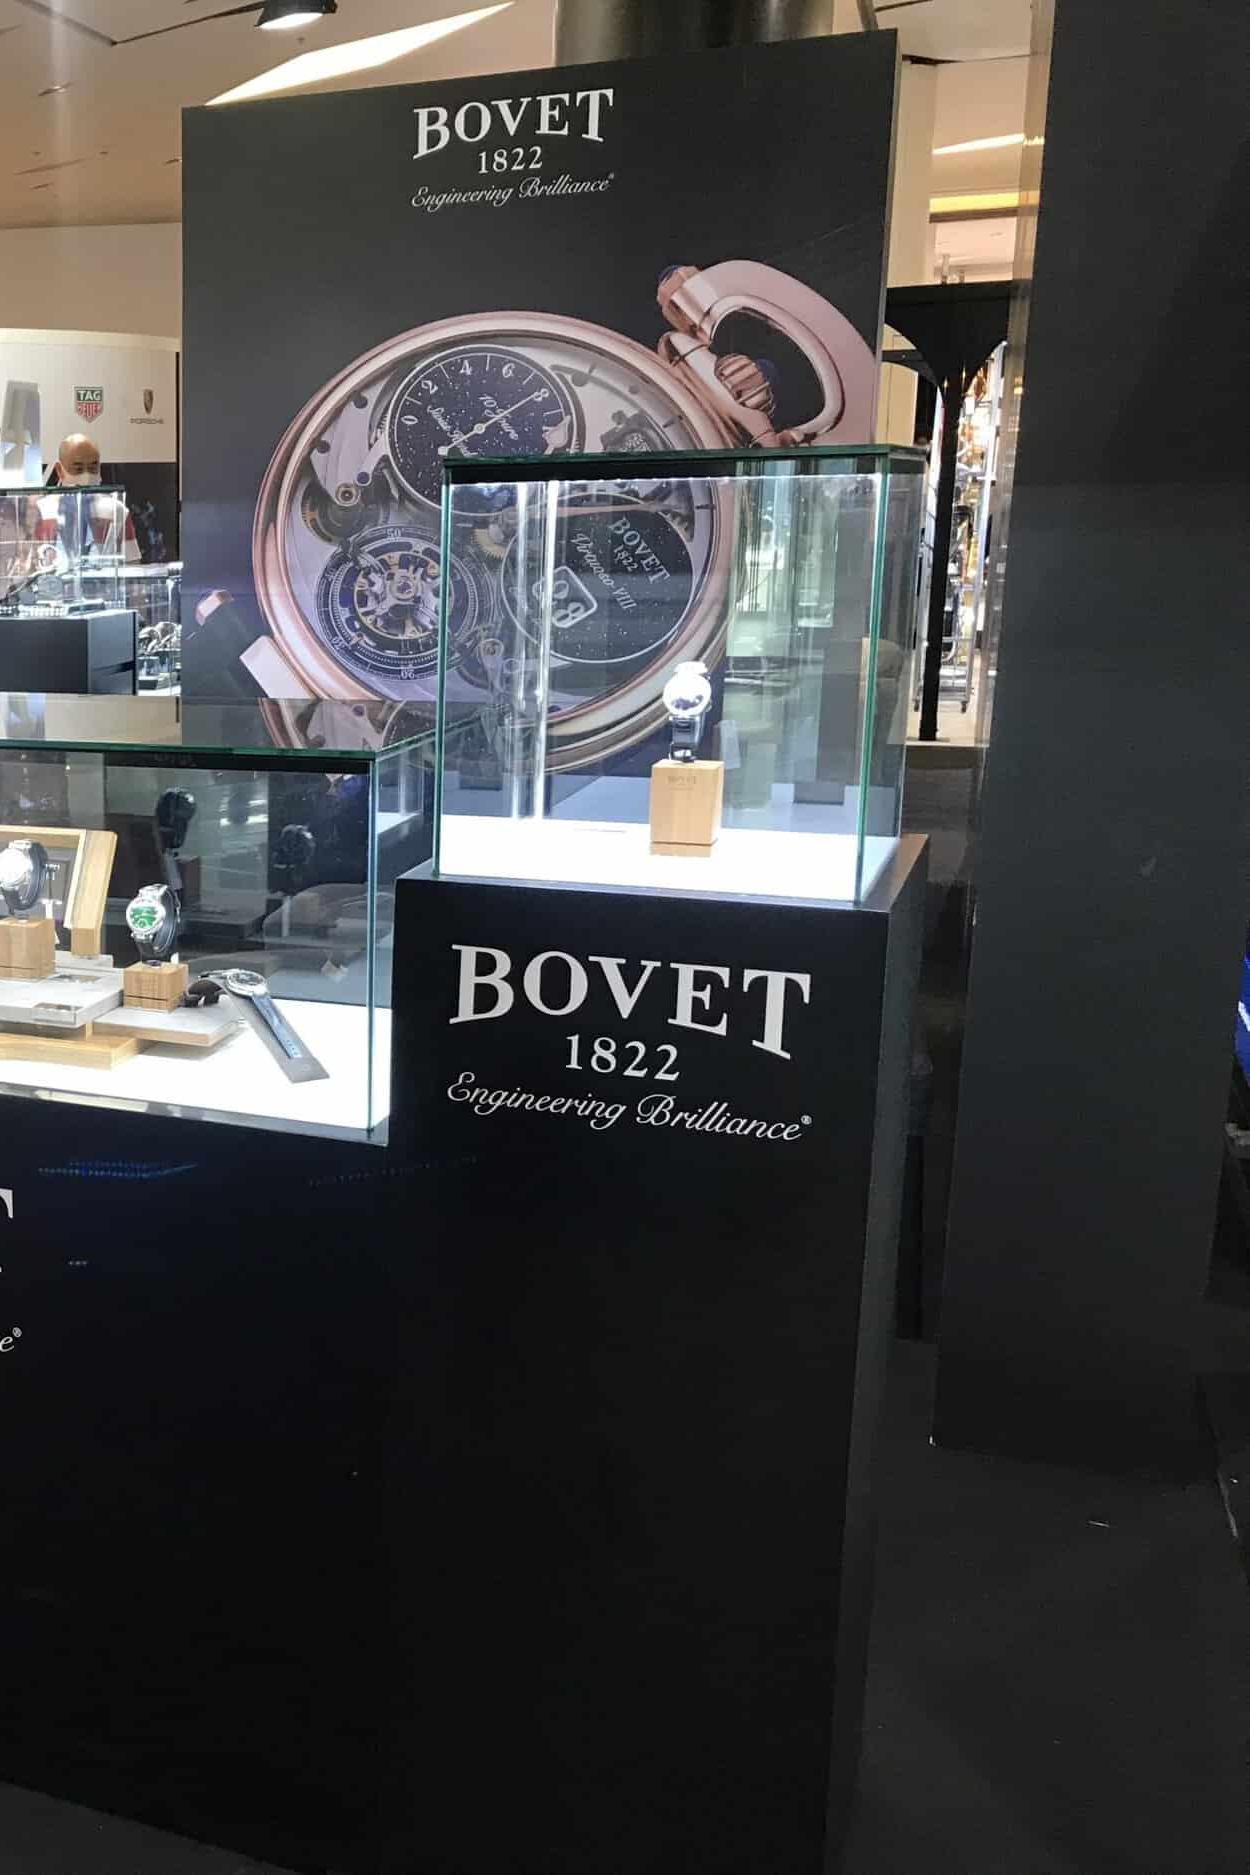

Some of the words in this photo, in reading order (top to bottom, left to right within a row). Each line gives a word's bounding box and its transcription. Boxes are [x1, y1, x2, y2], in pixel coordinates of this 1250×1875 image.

[413, 88, 614, 160] BOVET
[478, 146, 543, 174] 1822
[411, 185, 514, 212] Engineering
[78, 391, 101, 400] TAG
[607, 516, 670, 584] BOVET
[449, 944, 811, 1060] BOVET
[565, 1033, 681, 1081] 1822
[446, 1071, 627, 1130] Engineering
